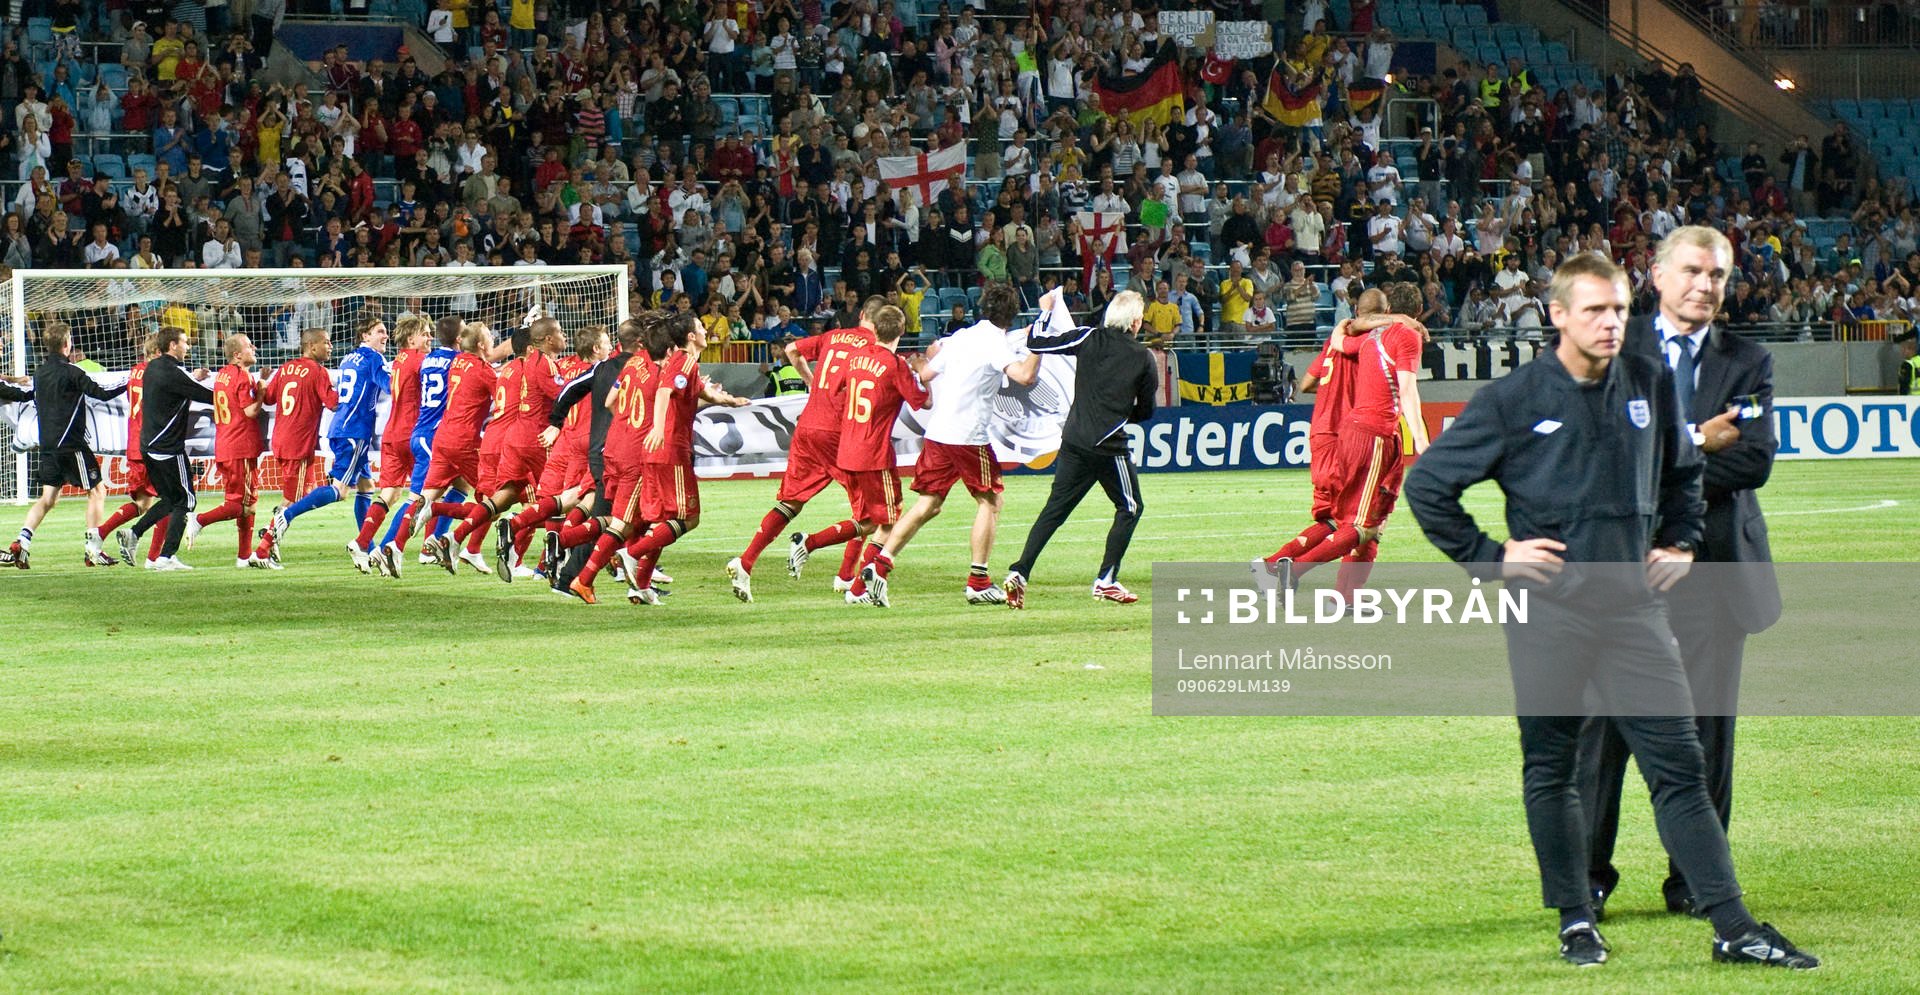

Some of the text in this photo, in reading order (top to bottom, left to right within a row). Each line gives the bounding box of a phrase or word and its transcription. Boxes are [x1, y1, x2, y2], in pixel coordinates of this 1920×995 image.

[1159, 11, 1213, 24] BERLIN
[1177, 34, 1194, 46] 65
[280, 364, 309, 378] AOGO
[281, 381, 298, 416] 6
[421, 373, 444, 408] 12
[446, 375, 461, 410] 7
[847, 377, 875, 423] 16
[1197, 383, 1251, 402] VÄXJ
[1124, 411, 1310, 467] asterCa
[1773, 403, 1920, 455] TOT
